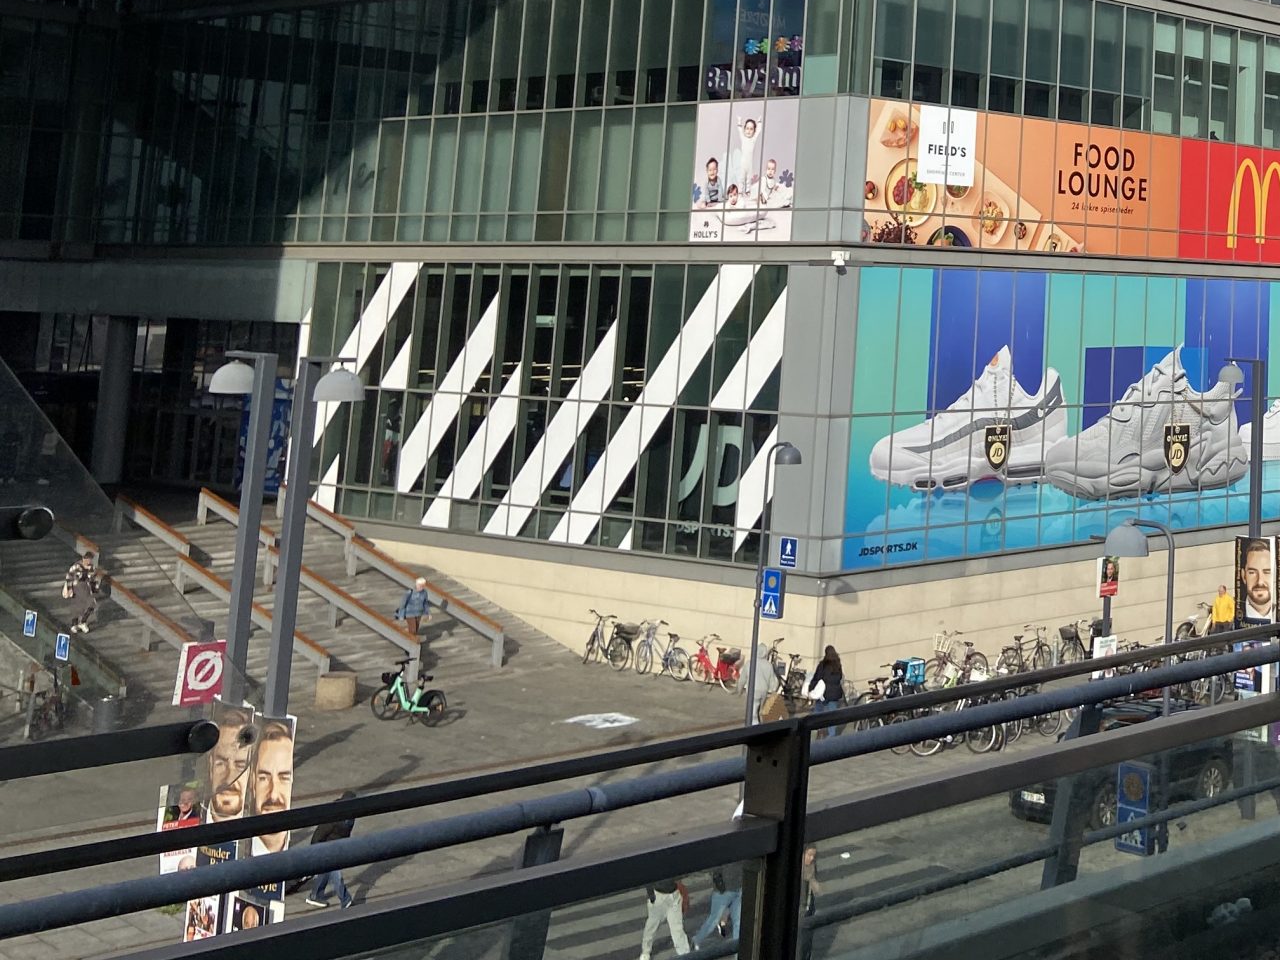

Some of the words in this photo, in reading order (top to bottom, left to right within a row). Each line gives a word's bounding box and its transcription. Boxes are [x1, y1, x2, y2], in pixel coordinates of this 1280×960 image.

[928, 144, 967, 157] FIELD'S
[1073, 143, 1135, 172] FOOD
[1058, 170, 1148, 202] LOUNGE
[1071, 202, 1080, 211] 24
[693, 230, 718, 239] HOLLY'S
